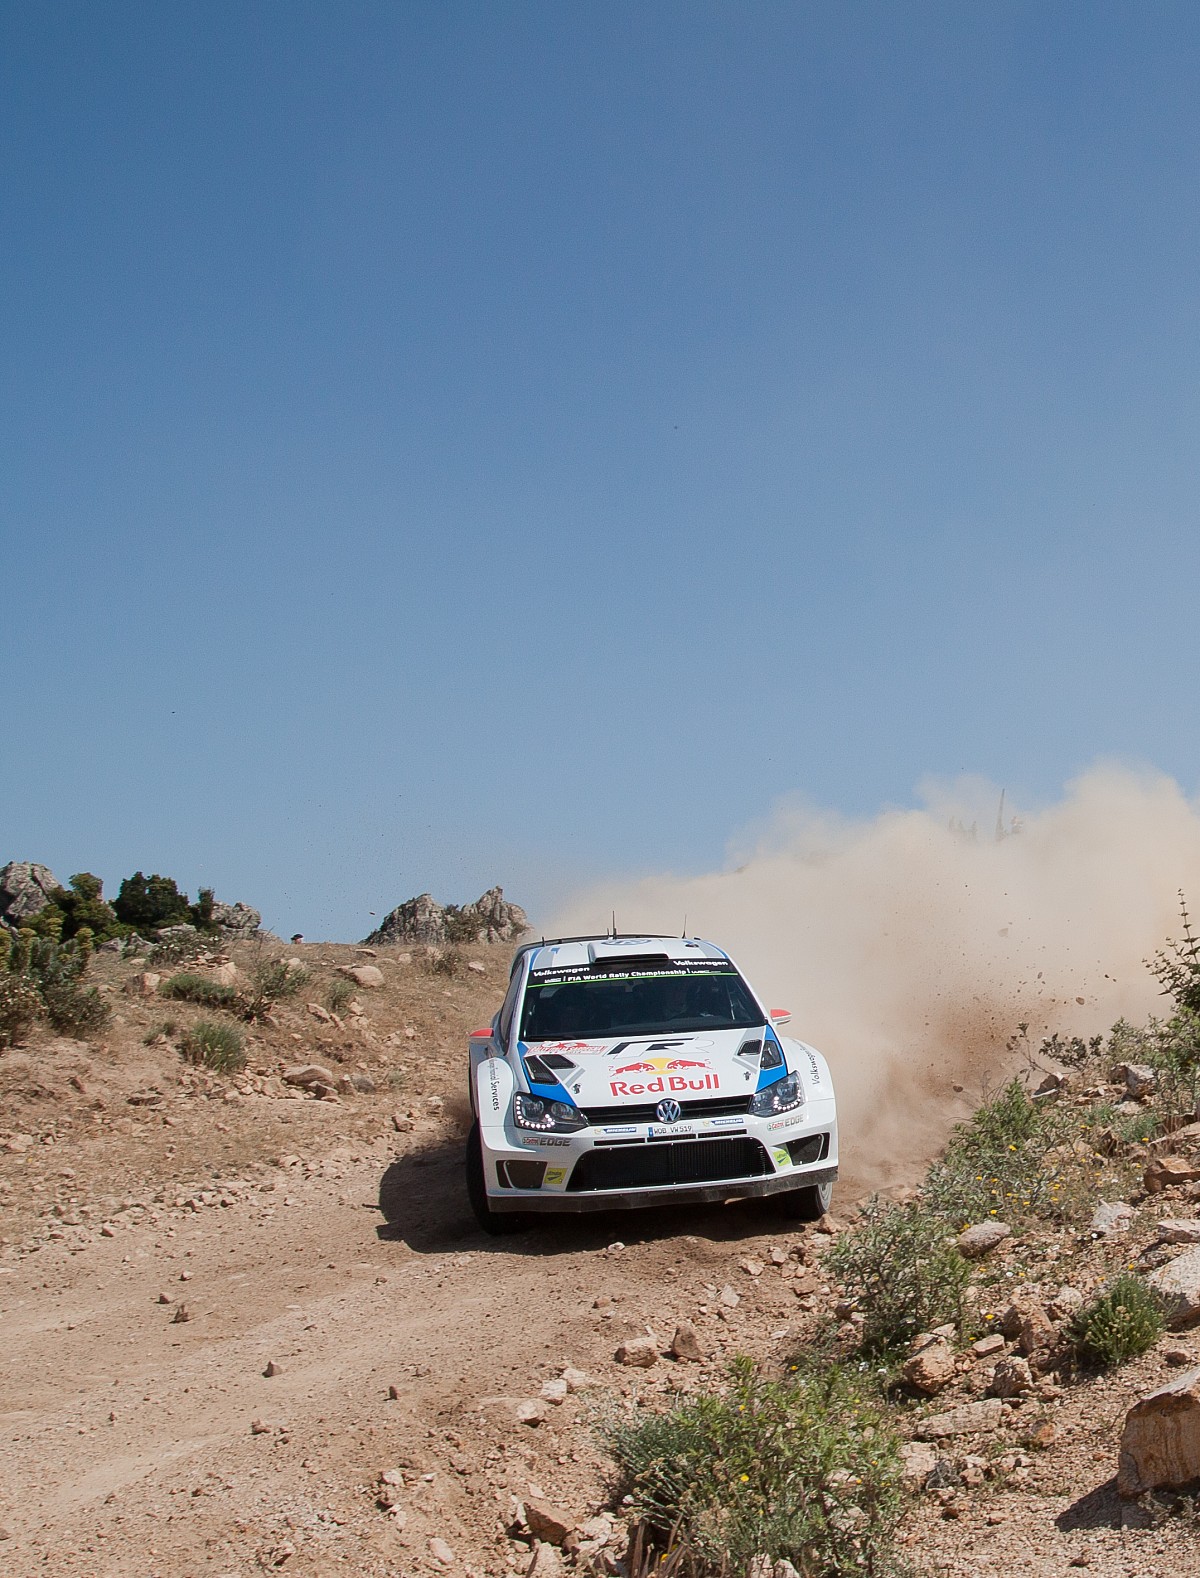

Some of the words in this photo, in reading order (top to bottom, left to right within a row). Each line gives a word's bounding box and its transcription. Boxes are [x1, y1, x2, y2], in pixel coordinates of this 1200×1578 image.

[533, 967, 590, 977] Volkswagen
[630, 969, 687, 977] Championship
[609, 1077, 662, 1097] Red
[668, 1073, 720, 1091] Bull
[491, 1080, 500, 1111] Services
[784, 1114, 804, 1127] EDGE
[654, 1126, 667, 1134] WOB
[540, 1137, 572, 1146] EDGE
